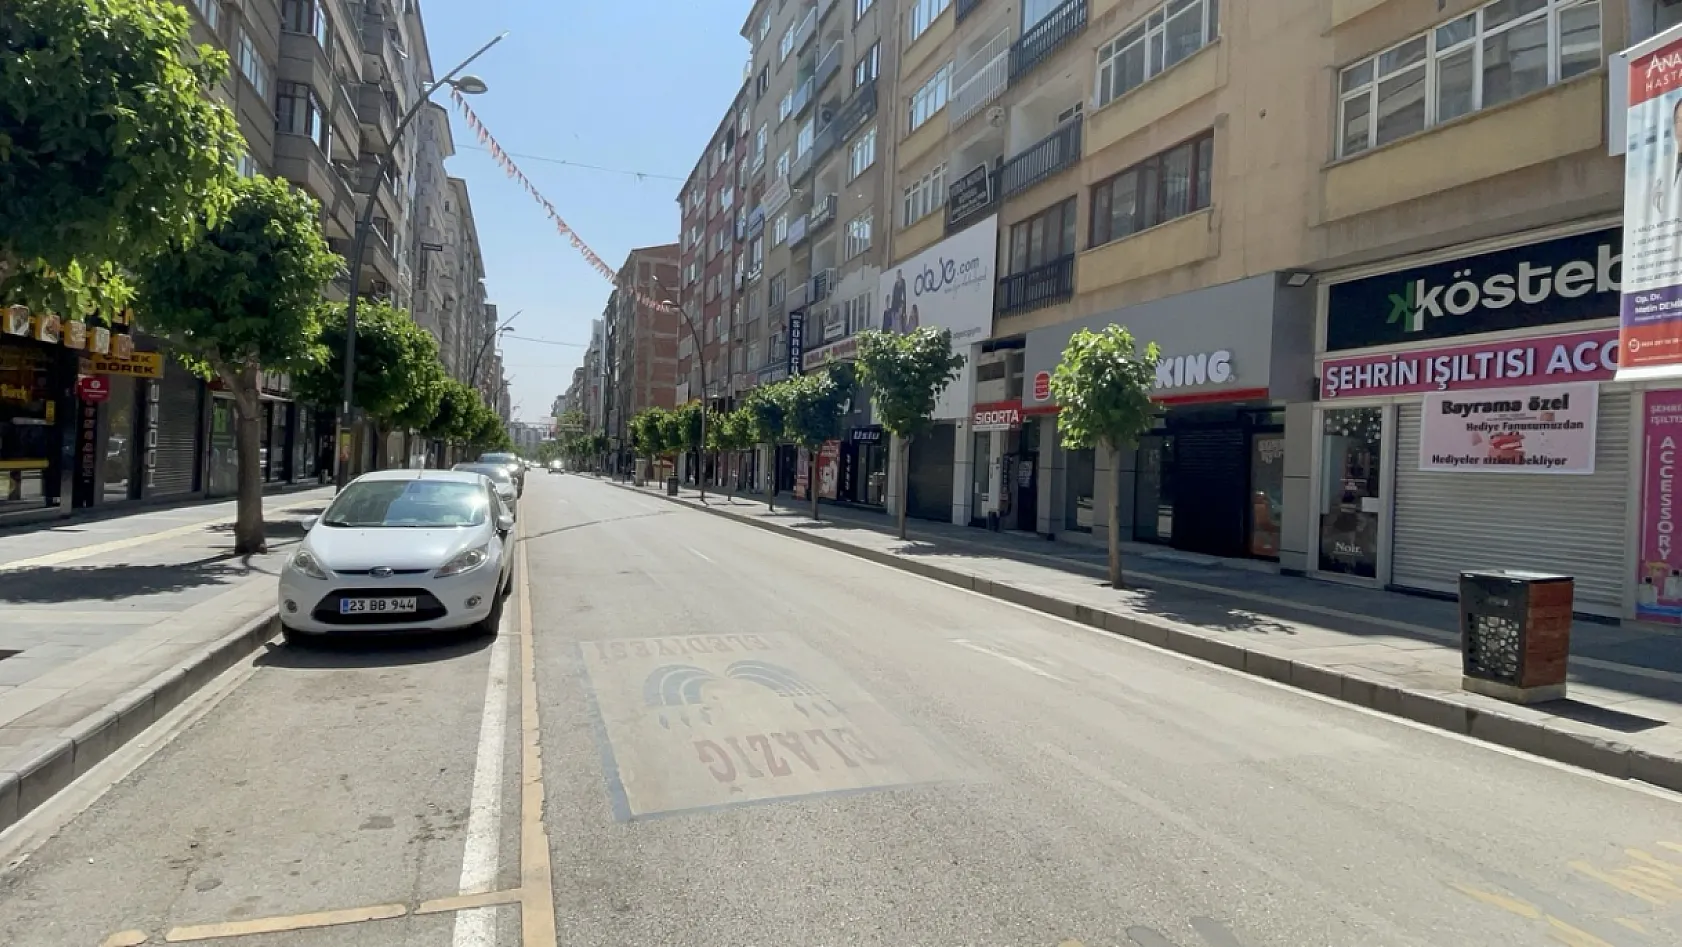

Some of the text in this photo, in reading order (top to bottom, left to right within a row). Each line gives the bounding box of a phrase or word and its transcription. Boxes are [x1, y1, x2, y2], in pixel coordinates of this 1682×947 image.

[1155, 350, 1230, 388] KING
[1326, 354, 1418, 397] ŞEHRİN
[1425, 347, 1535, 390] IŞILTISI
[1442, 399, 1522, 417] Bayrama
[1528, 393, 1570, 411] özel
[1466, 422, 1499, 433] Hediye
[1432, 454, 1479, 466] Hediyeler
[1518, 454, 1568, 468] bekliyor
[1657, 435, 1676, 560] ACCESSORY
[350, 598, 414, 611] 23 BB 944
